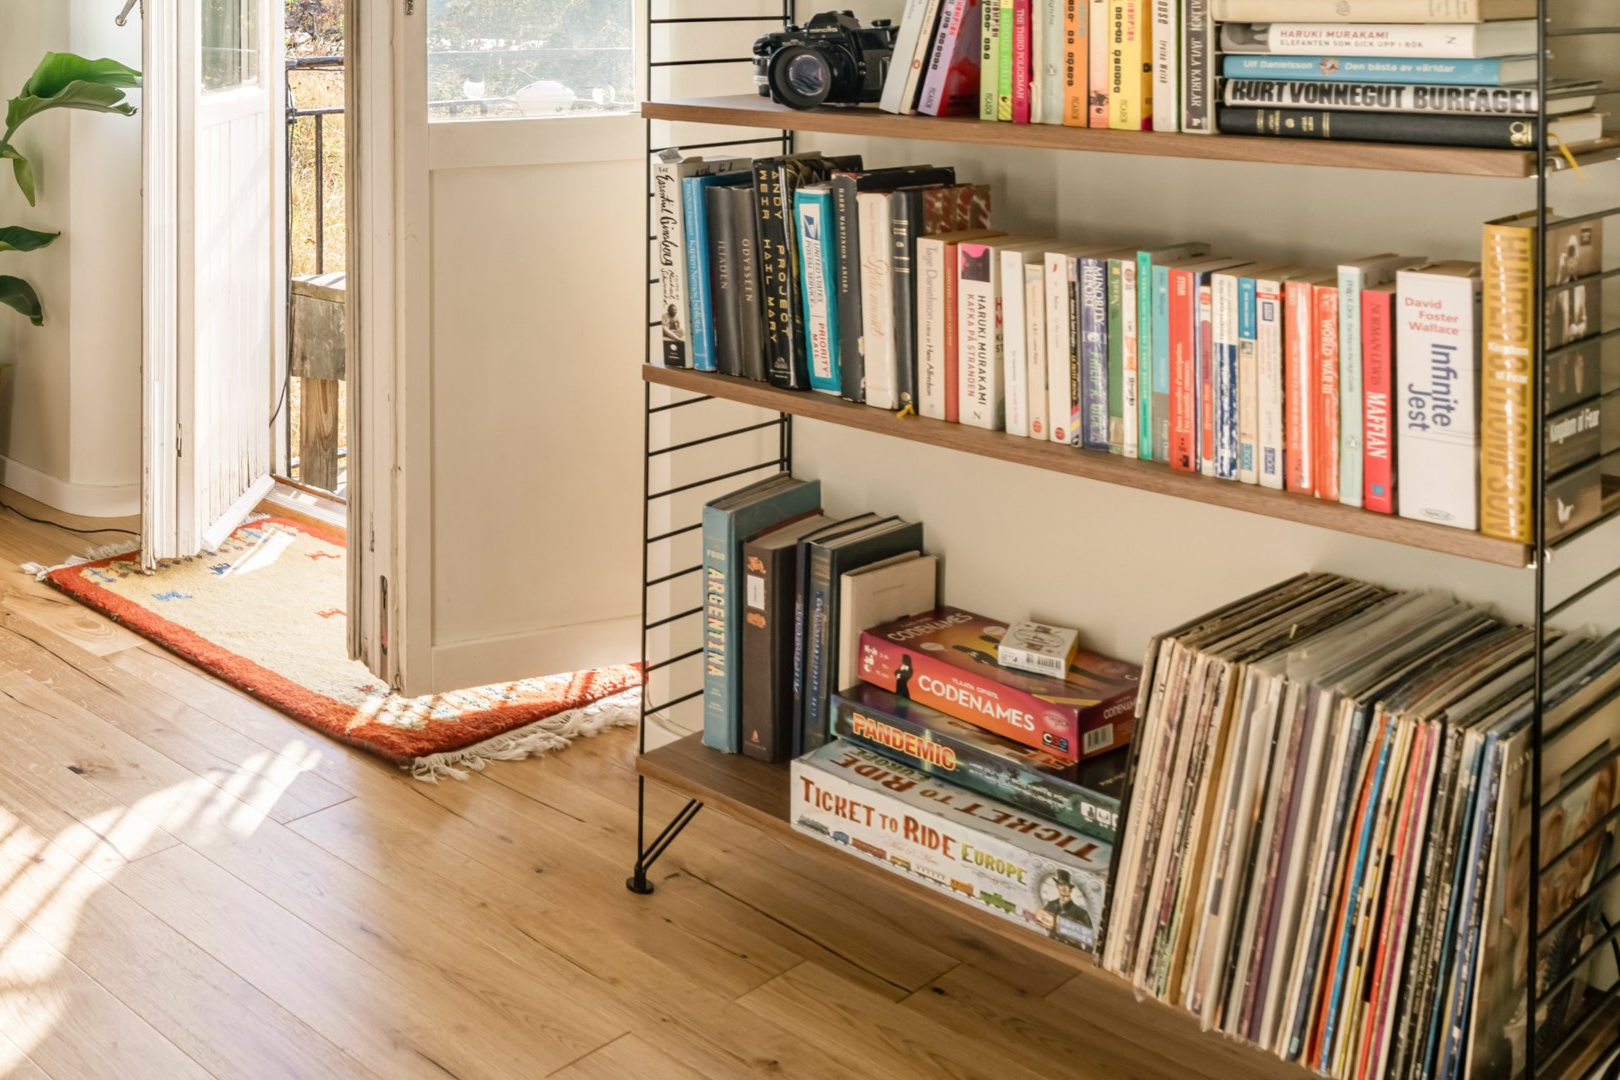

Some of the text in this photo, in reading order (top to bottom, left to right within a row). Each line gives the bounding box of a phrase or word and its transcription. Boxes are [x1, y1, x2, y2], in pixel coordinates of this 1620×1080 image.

[1017, 8, 1026, 25] THE
[1017, 25, 1026, 50] THIRD
[1280, 29, 1390, 40] HARUKI MURAKAMI
[1001, 12, 1010, 92] ALDOUS HUXLEY
[1017, 50, 1026, 99] POLICEMAN
[1190, 37, 1203, 67] JÄVLA
[1345, 62, 1366, 71] Den
[1190, 68, 1202, 107] KARLAR
[1230, 79, 1290, 104] KURT
[1290, 81, 1407, 108] VONNEGUT
[760, 170, 770, 220] WEIR
[771, 170, 782, 220] ANDY
[718, 240, 728, 290] ILIADEN
[742, 238, 754, 303] ODYSSEEN
[805, 240, 814, 271] POSTAL
[813, 243, 824, 303] UNITED STATES
[764, 239, 777, 343] HAIL MARY
[777, 244, 789, 338] PROJECT
[1084, 264, 1095, 309] REPORT
[1093, 264, 1105, 327] MINORITY
[1404, 297, 1442, 309] David
[1321, 319, 1334, 357] WORLD
[1408, 322, 1459, 336] Wallace
[1417, 310, 1459, 323] Foster
[812, 333, 820, 359] MAIL
[818, 322, 829, 375] PRIORITY
[966, 293, 977, 397] KAFKA PÅ STRANDEN
[977, 295, 988, 406] HARUKI MURAKAMI
[1322, 359, 1334, 382] WAR
[1365, 303, 1388, 458] NORMAN LEWIS MAFFIAN
[1430, 342, 1458, 427] Infinite
[1407, 382, 1432, 431] Jest
[706, 567, 726, 677] ARGENTINA
[886, 612, 974, 642] CODENAMES
[917, 674, 1036, 733] CODENAMES
[851, 711, 957, 772] PANDEMIC
[799, 775, 1028, 886] TICKET TO RIDE EUROPE
[829, 752, 1102, 863] RIDE TO TICKET
